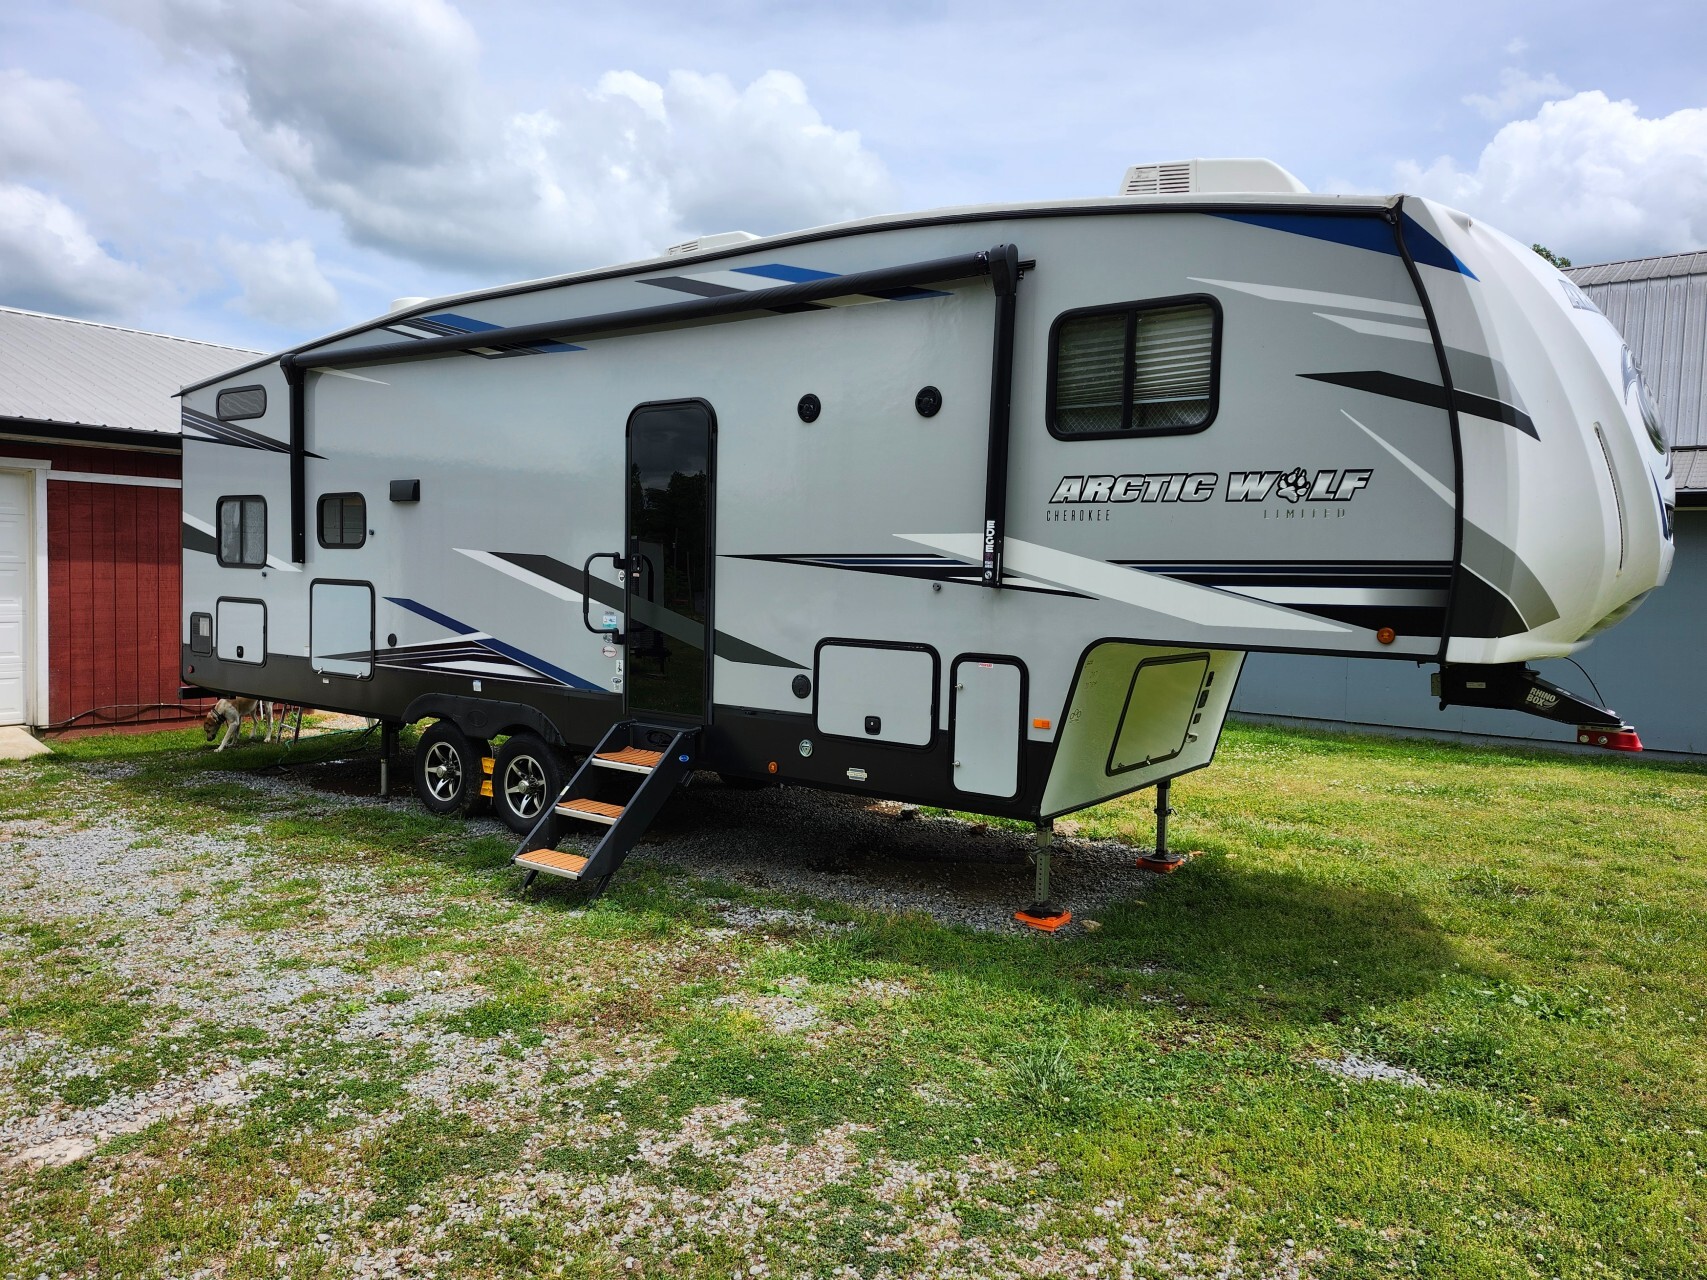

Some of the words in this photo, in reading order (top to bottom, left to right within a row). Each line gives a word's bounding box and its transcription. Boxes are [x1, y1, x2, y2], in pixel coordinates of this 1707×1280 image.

[1049, 474, 1218, 503] ARCTIC
[1046, 509, 1111, 521] CHEROKEE
[1263, 508, 1345, 519] LIMITED
[985, 520, 996, 553] EDGE
[1526, 693, 1545, 706] BOX
[1530, 687, 1556, 702] RHINO
